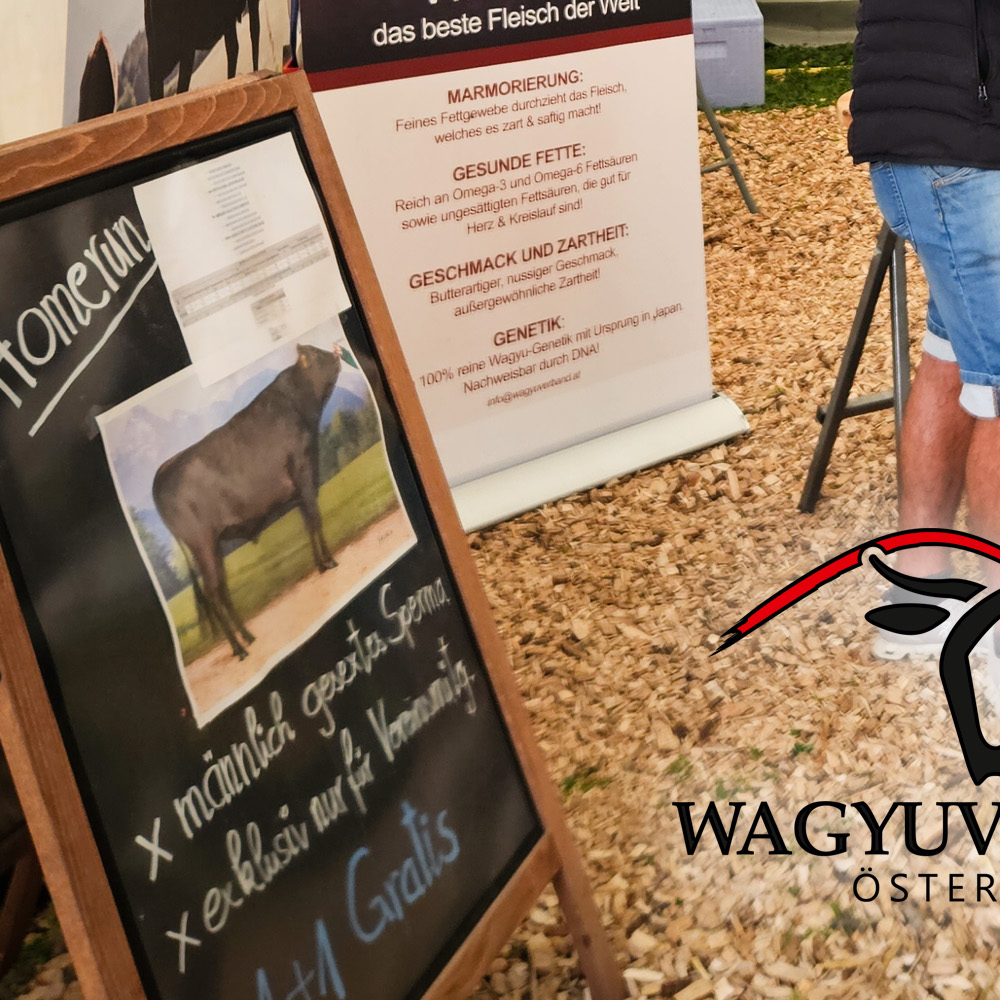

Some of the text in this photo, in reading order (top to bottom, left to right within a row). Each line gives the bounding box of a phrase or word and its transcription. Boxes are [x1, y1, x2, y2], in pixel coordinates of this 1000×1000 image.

[372, 21, 416, 47] das
[421, 11, 482, 40] beste
[487, 0, 560, 32] Fleisch
[395, 81, 628, 132] Feines Fettgewebe durchzieht das Fleisch,
[447, 69, 584, 105] MARMORIERUNG:
[434, 102, 602, 144] welches es zart & saftig macht!
[395, 151, 638, 213] Reich an Omega-3 und Omega-6 Fettsäuren
[452, 143, 586, 182] GESUNDE FETTE:
[401, 169, 632, 230] sowie ungesättigten Fettsäuren, die gut für
[467, 198, 583, 235] Herz & Kreislauf sind!
[409, 223, 630, 290] GESCHMACK UND ZARTHEIT:
[430, 247, 619, 304] Butterartiger, nussiger Geschmack,
[454, 267, 601, 317] außergewöhnliche Zartheit!
[419, 301, 685, 388] 100% reine Wagyu-Genetik mit Ursprung in Japan.
[493, 314, 566, 347] GENETIK:
[463, 343, 600, 394] Nachweisbar durch DNA!
[486, 371, 582, 407] info@wagyuverband.at
[173, 691, 296, 840] männlich
[347, 800, 461, 943] Gratis
